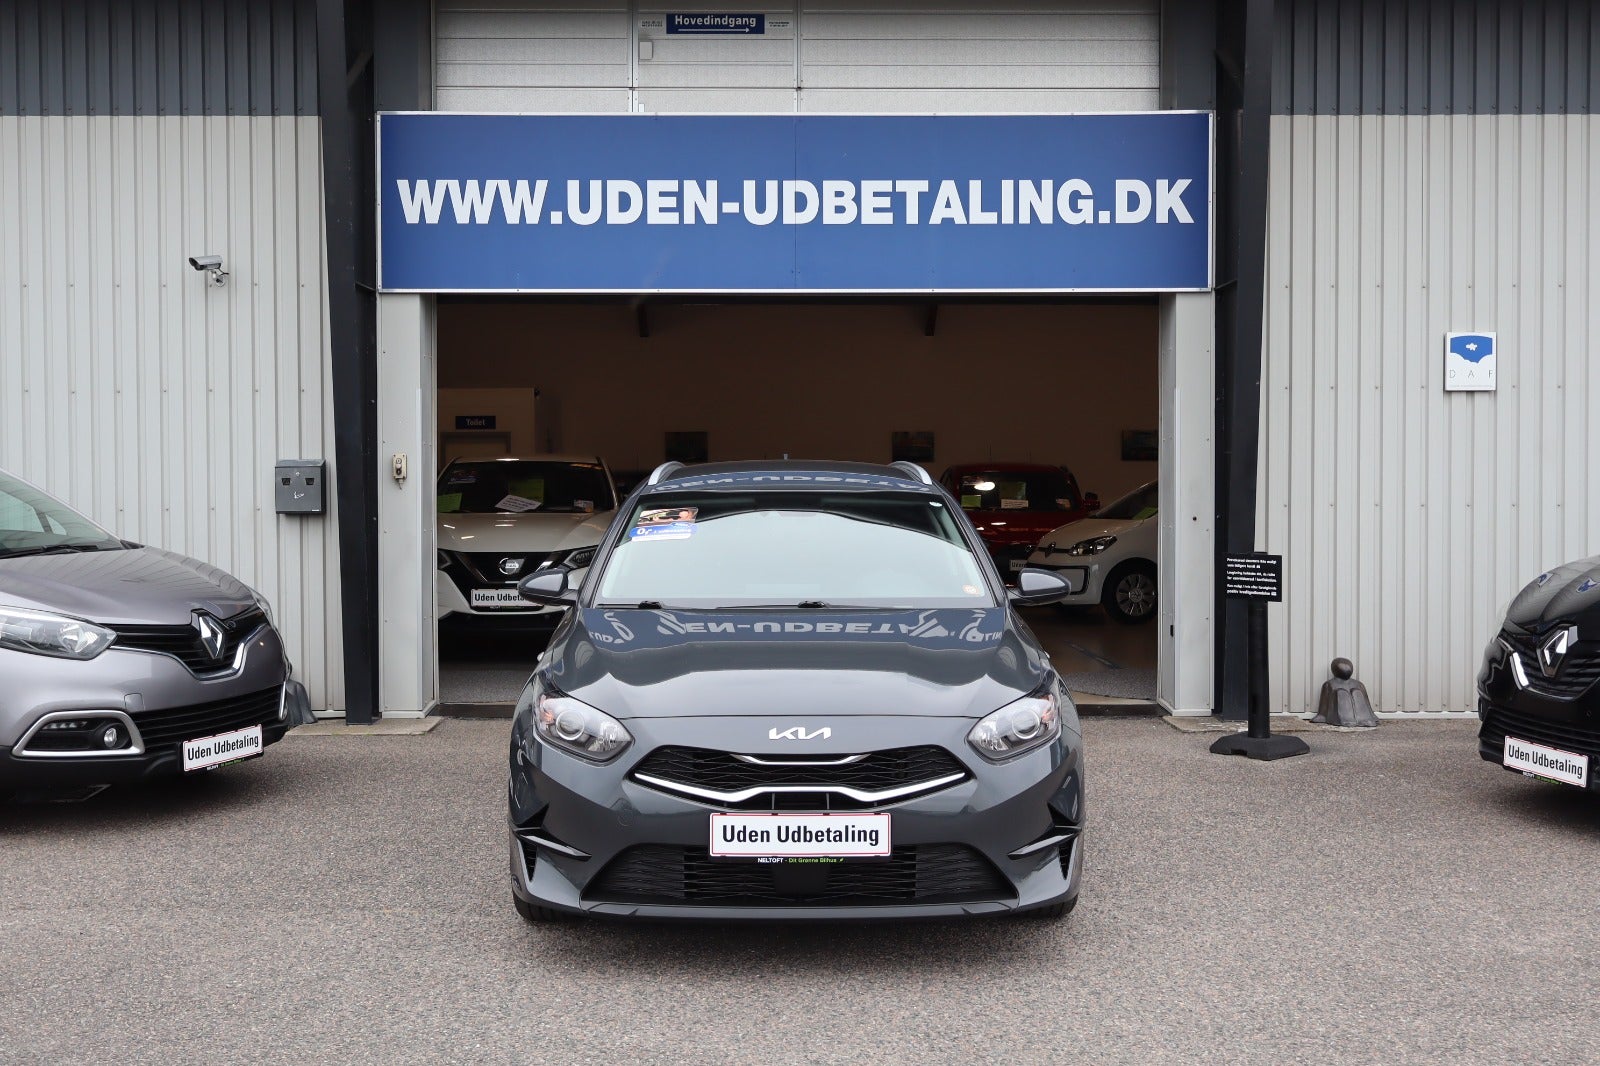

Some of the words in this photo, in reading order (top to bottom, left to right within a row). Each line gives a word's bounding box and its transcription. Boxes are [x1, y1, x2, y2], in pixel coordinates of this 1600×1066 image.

[674, 14, 757, 27] Hovedindgang
[396, 178, 1195, 226] WWW.UDEN-UDBETALING.DK
[465, 418, 486, 426] Toilet
[474, 593, 495, 601] Uden
[187, 747, 212, 760] Uden
[214, 735, 259, 755] Udbetaling
[1508, 744, 1530, 763] Uden
[1532, 751, 1583, 779] Udbetaling
[722, 825, 770, 843] Uden
[777, 825, 880, 847] Udbetaling
